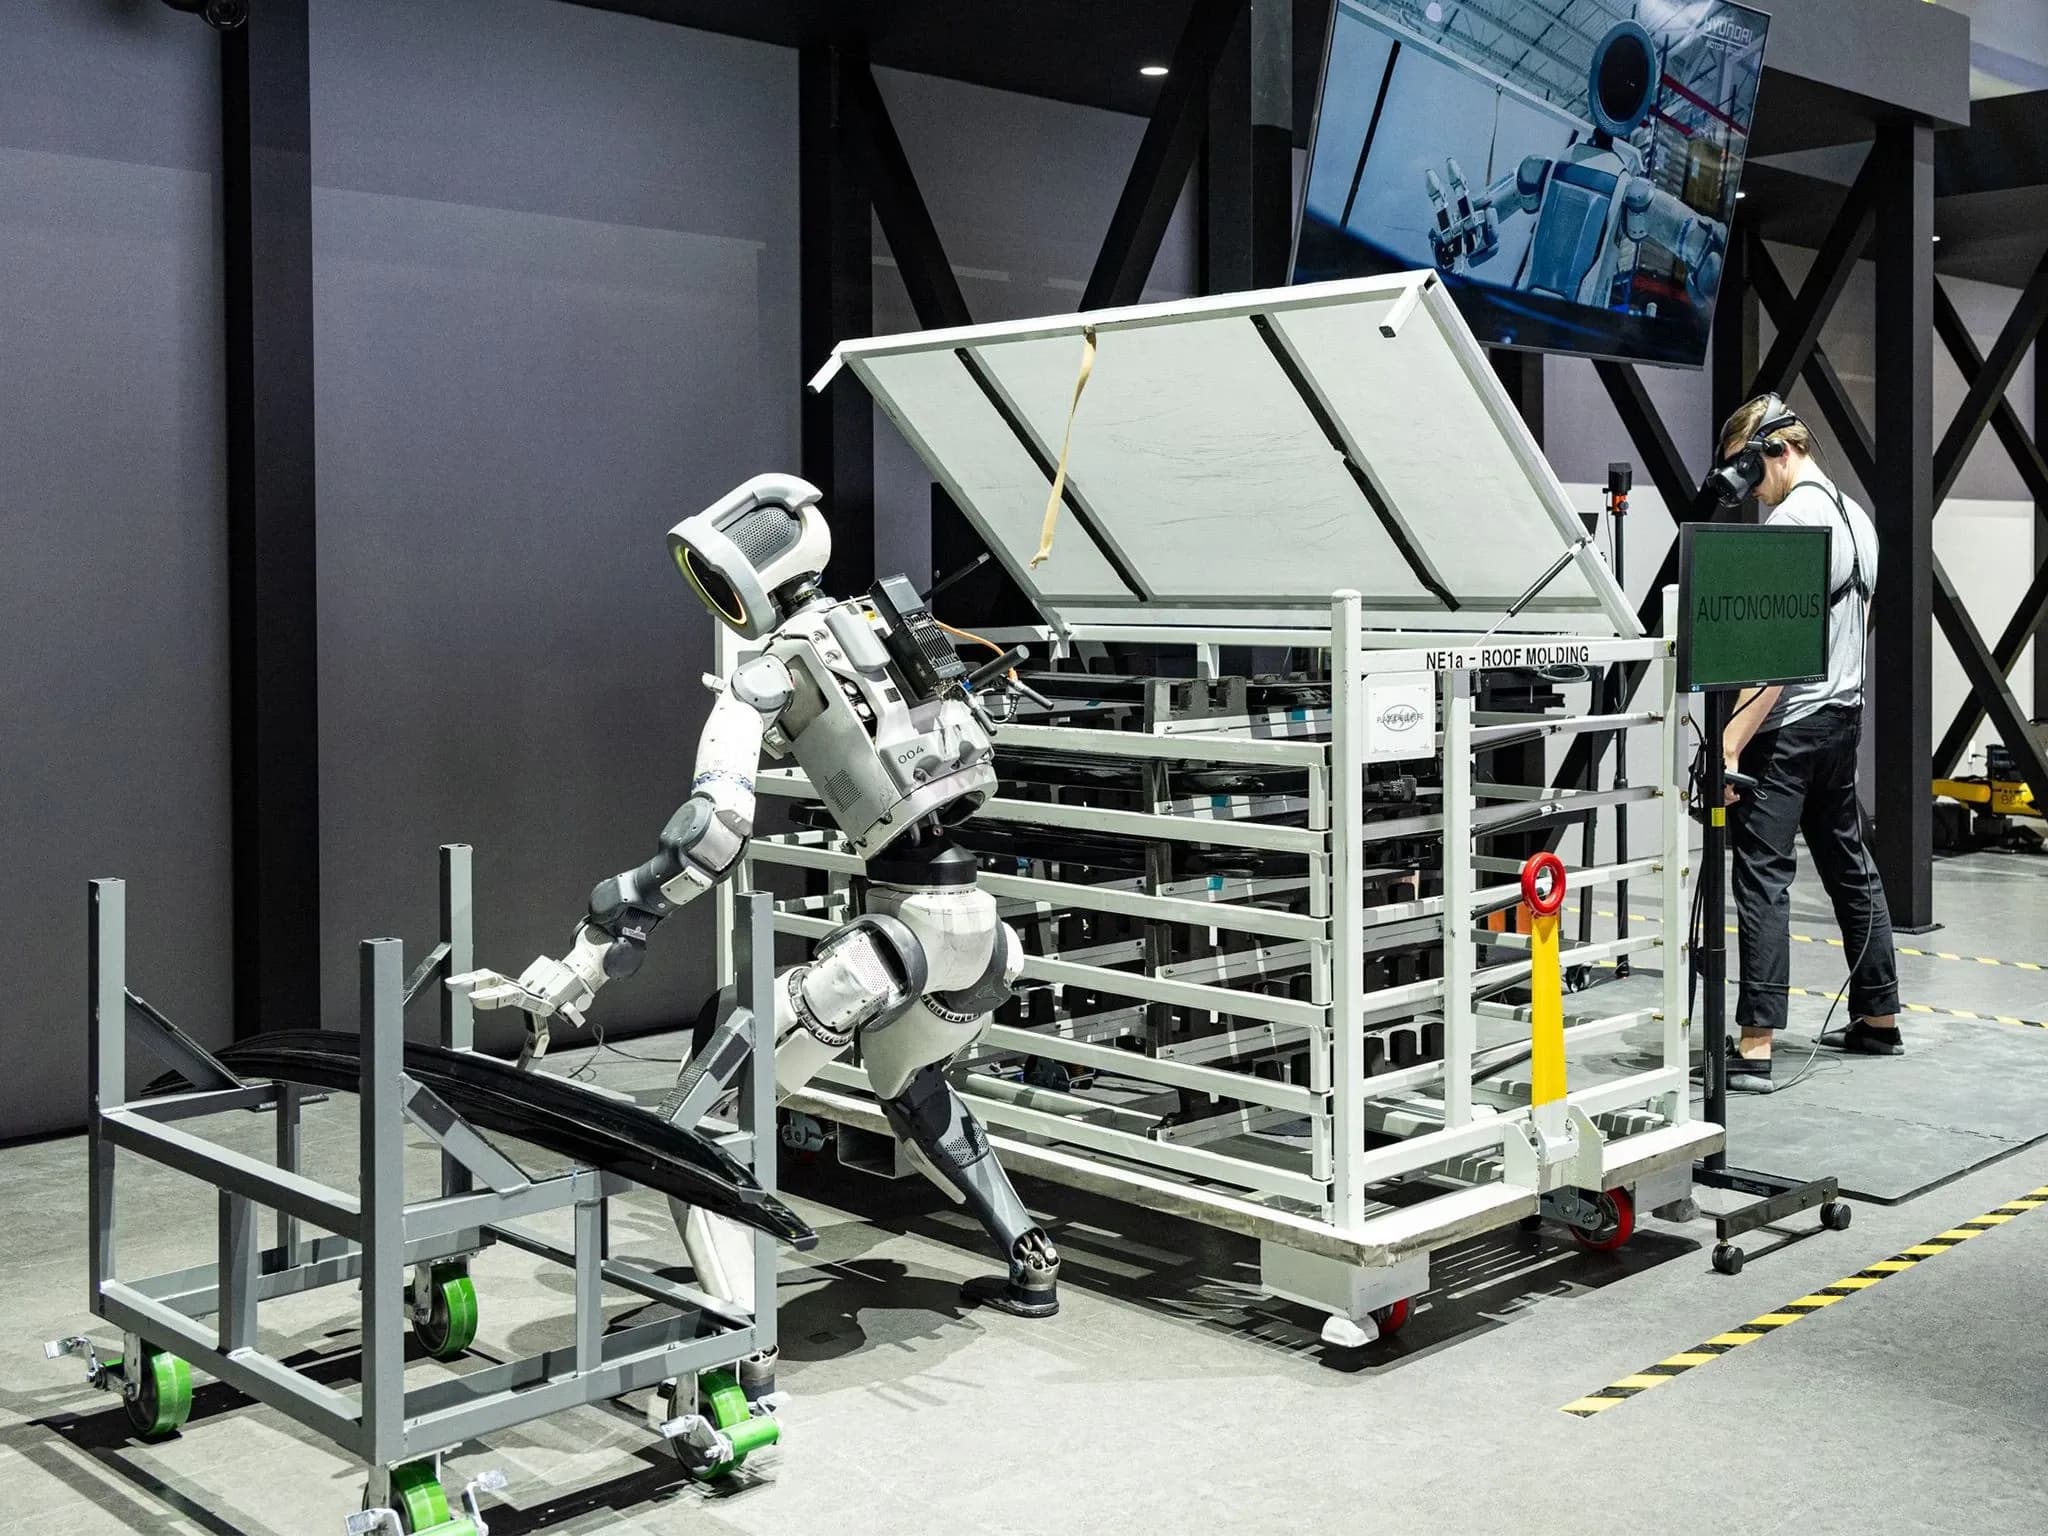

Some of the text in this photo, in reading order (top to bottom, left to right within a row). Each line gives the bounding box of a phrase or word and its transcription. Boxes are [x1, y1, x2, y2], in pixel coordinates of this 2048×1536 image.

[1696, 593, 1820, 623] AUTONOMOUS
[1426, 651, 1463, 670] NE1a
[1481, 648, 1522, 667] ROOF
[1526, 645, 1589, 665] MOLDING
[898, 745, 924, 764] 004
